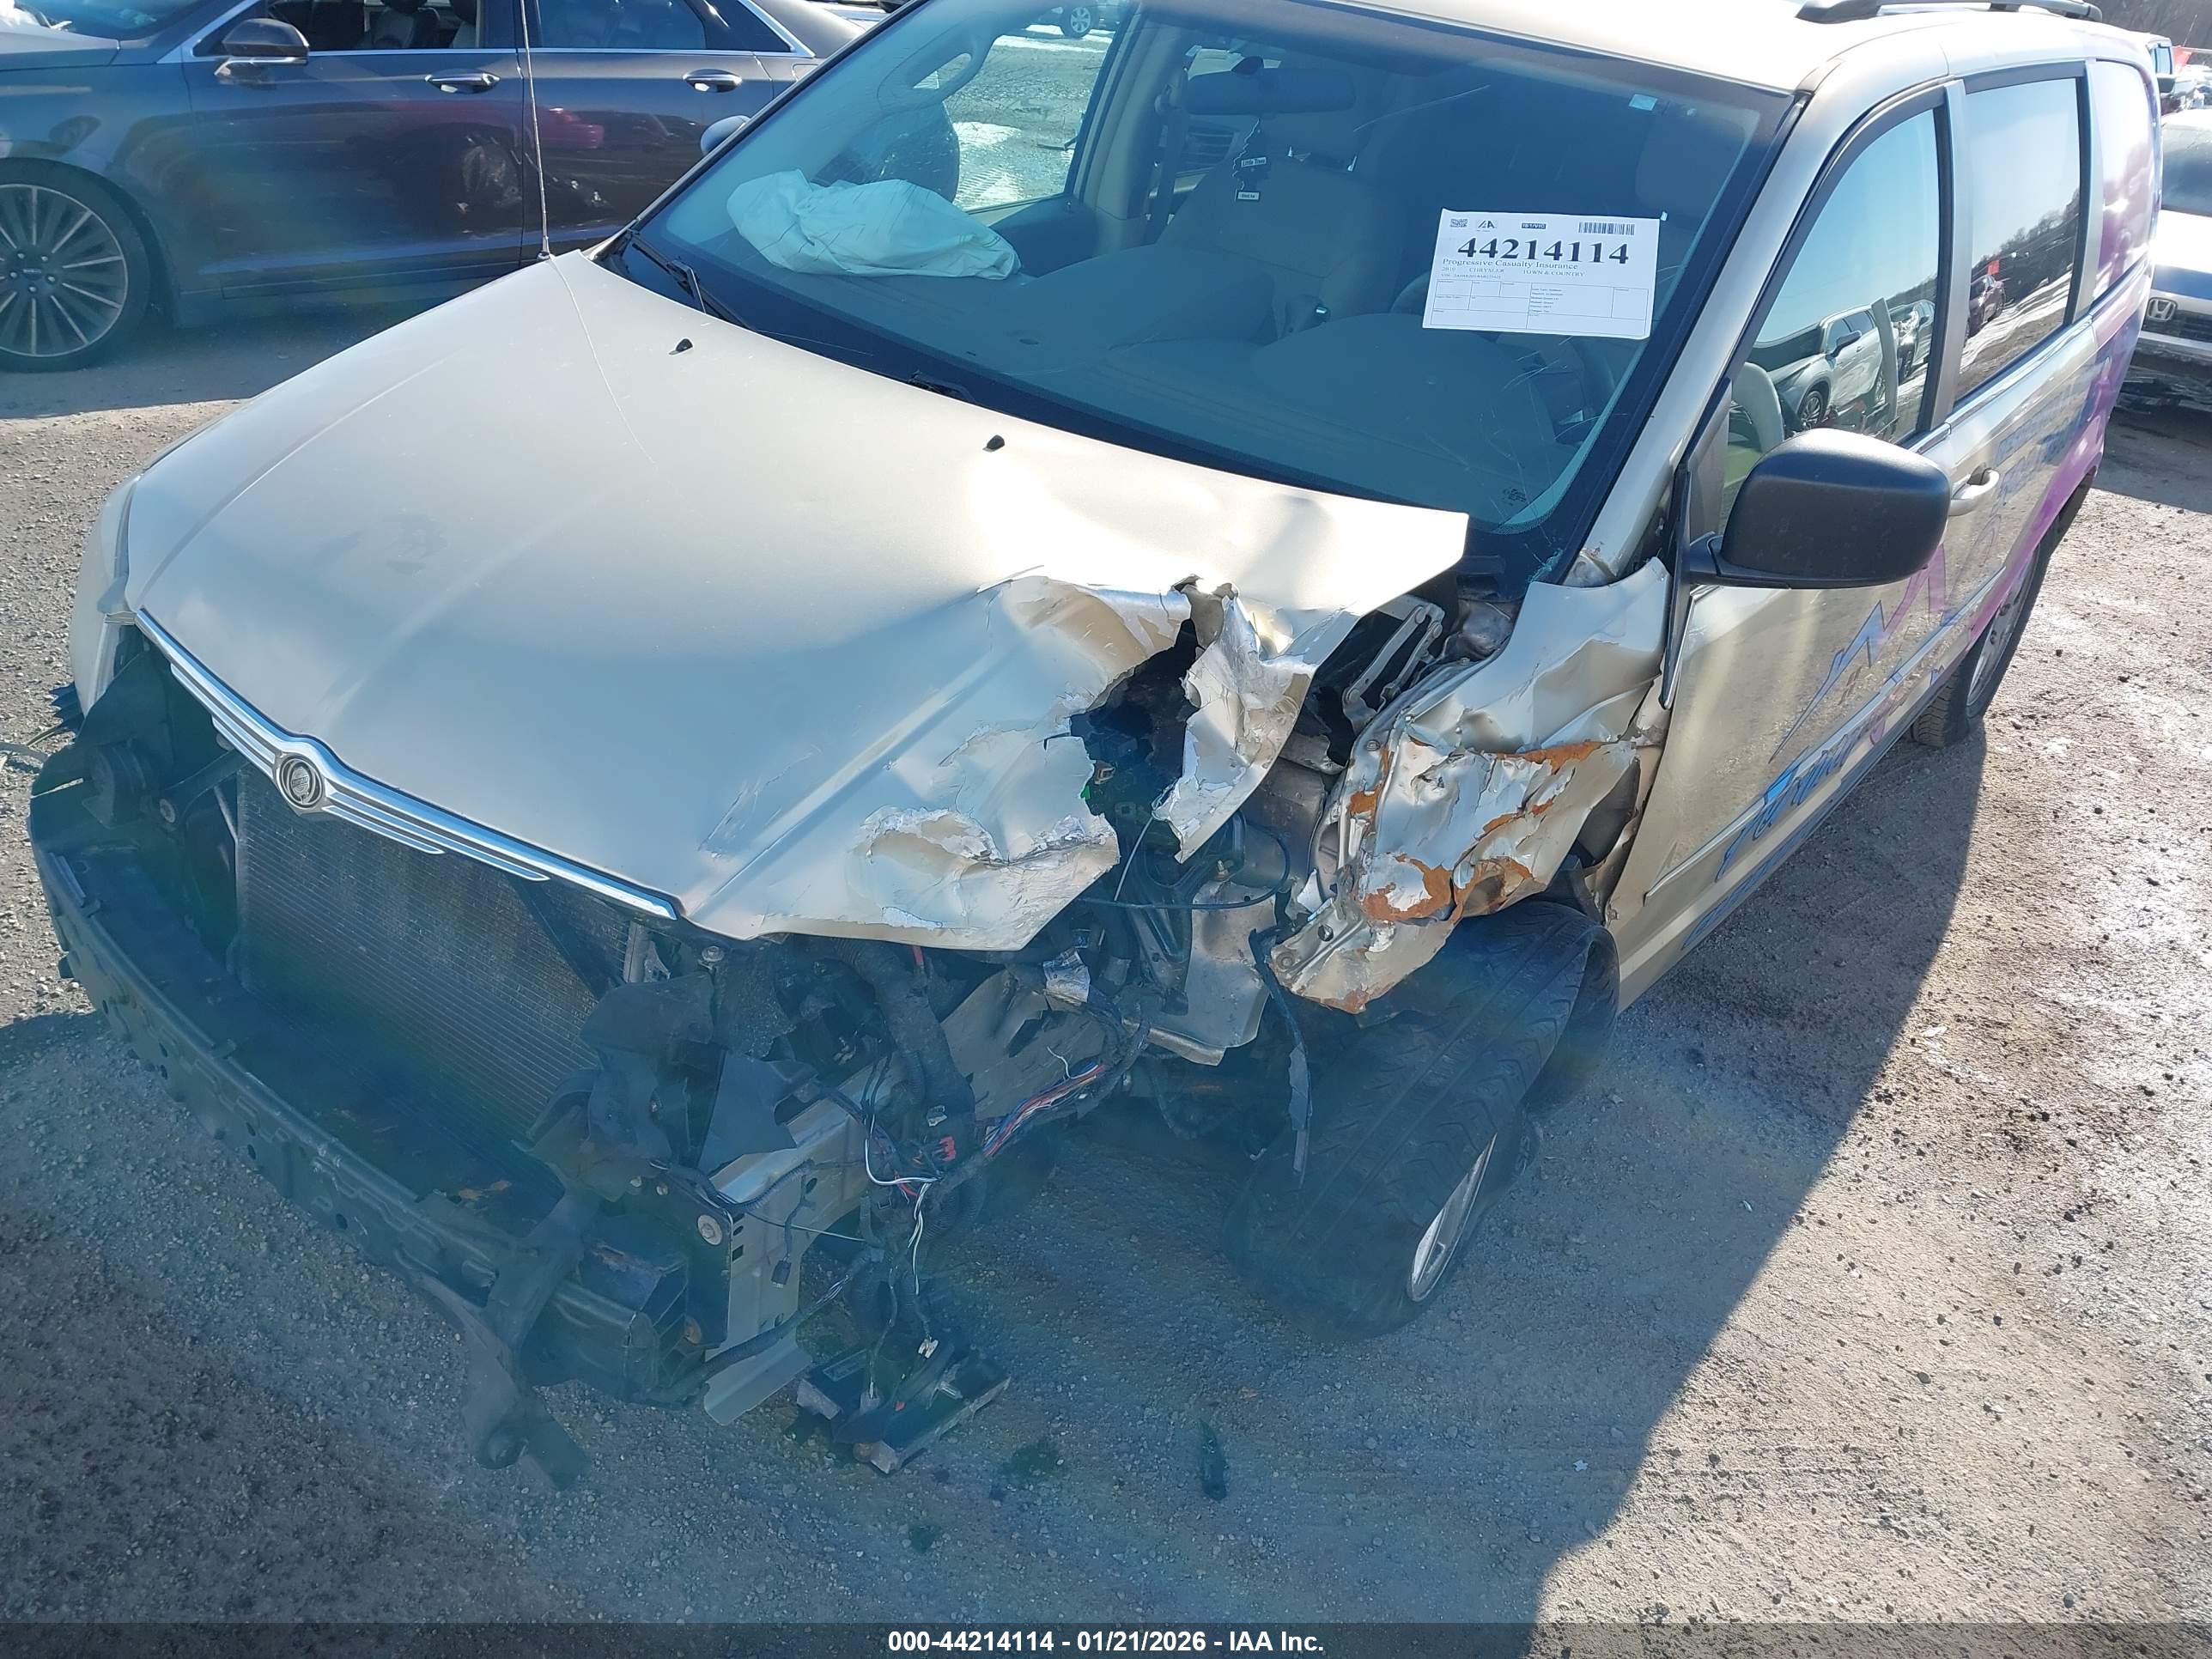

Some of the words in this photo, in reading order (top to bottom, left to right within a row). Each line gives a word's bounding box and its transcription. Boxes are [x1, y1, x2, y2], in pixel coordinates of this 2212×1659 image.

[1458, 237, 1629, 264] 44214114
[1443, 258, 1493, 267] Progressive
[1495, 259, 1534, 269] Casualty
[1535, 261, 1578, 270] Insurance
